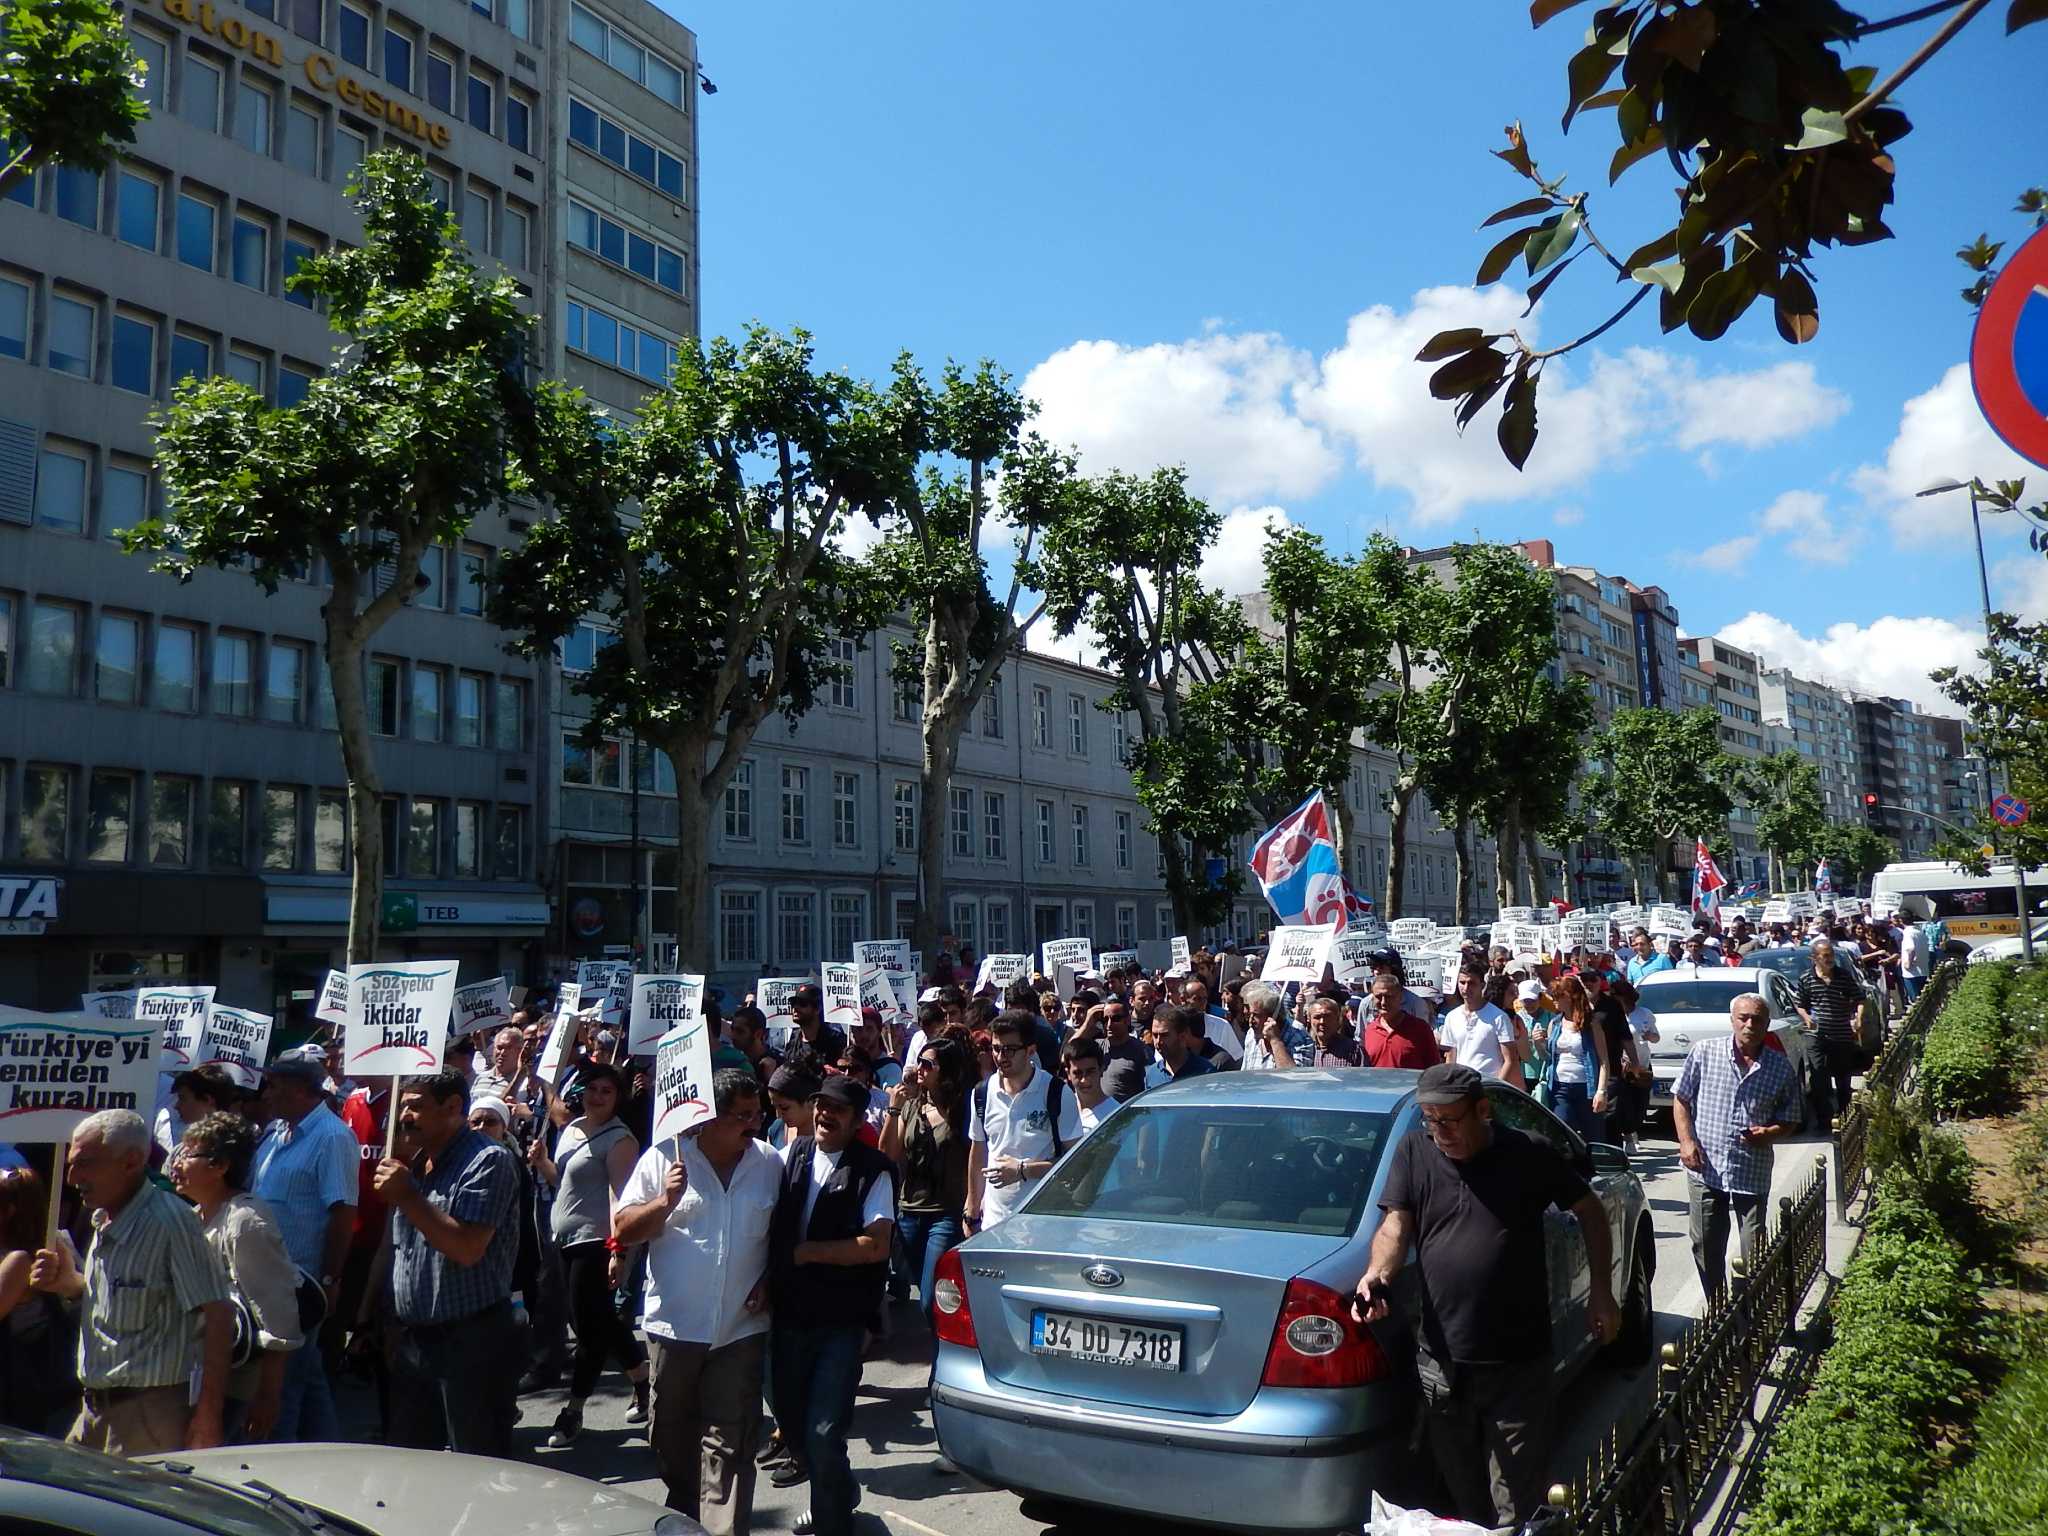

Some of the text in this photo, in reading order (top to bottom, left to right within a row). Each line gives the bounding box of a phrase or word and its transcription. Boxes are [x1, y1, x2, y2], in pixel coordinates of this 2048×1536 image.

[137, 0, 450, 148] aton Cesme
[0, 879, 58, 917] TA
[424, 907, 459, 920] TEB
[1281, 945, 1314, 956] iktidar
[1287, 956, 1315, 968] halka
[361, 986, 401, 1003] karar
[647, 990, 682, 1003] karar
[142, 999, 205, 1018] Türkiye'yi
[363, 1003, 422, 1025] iktidar
[473, 1006, 501, 1018] halka
[213, 1014, 267, 1041] Türkiye'yi
[382, 1026, 428, 1048] halka
[206, 1031, 251, 1051] yeniden
[214, 1046, 257, 1067] kuralım
[0, 1059, 109, 1083] eniden
[10, 1085, 137, 1109] kuralım
[666, 1083, 698, 1111] halka
[1090, 1270, 1113, 1283] Ford
[1034, 1332, 1044, 1340] TR
[1045, 1318, 1172, 1363] 34 DD 7318
